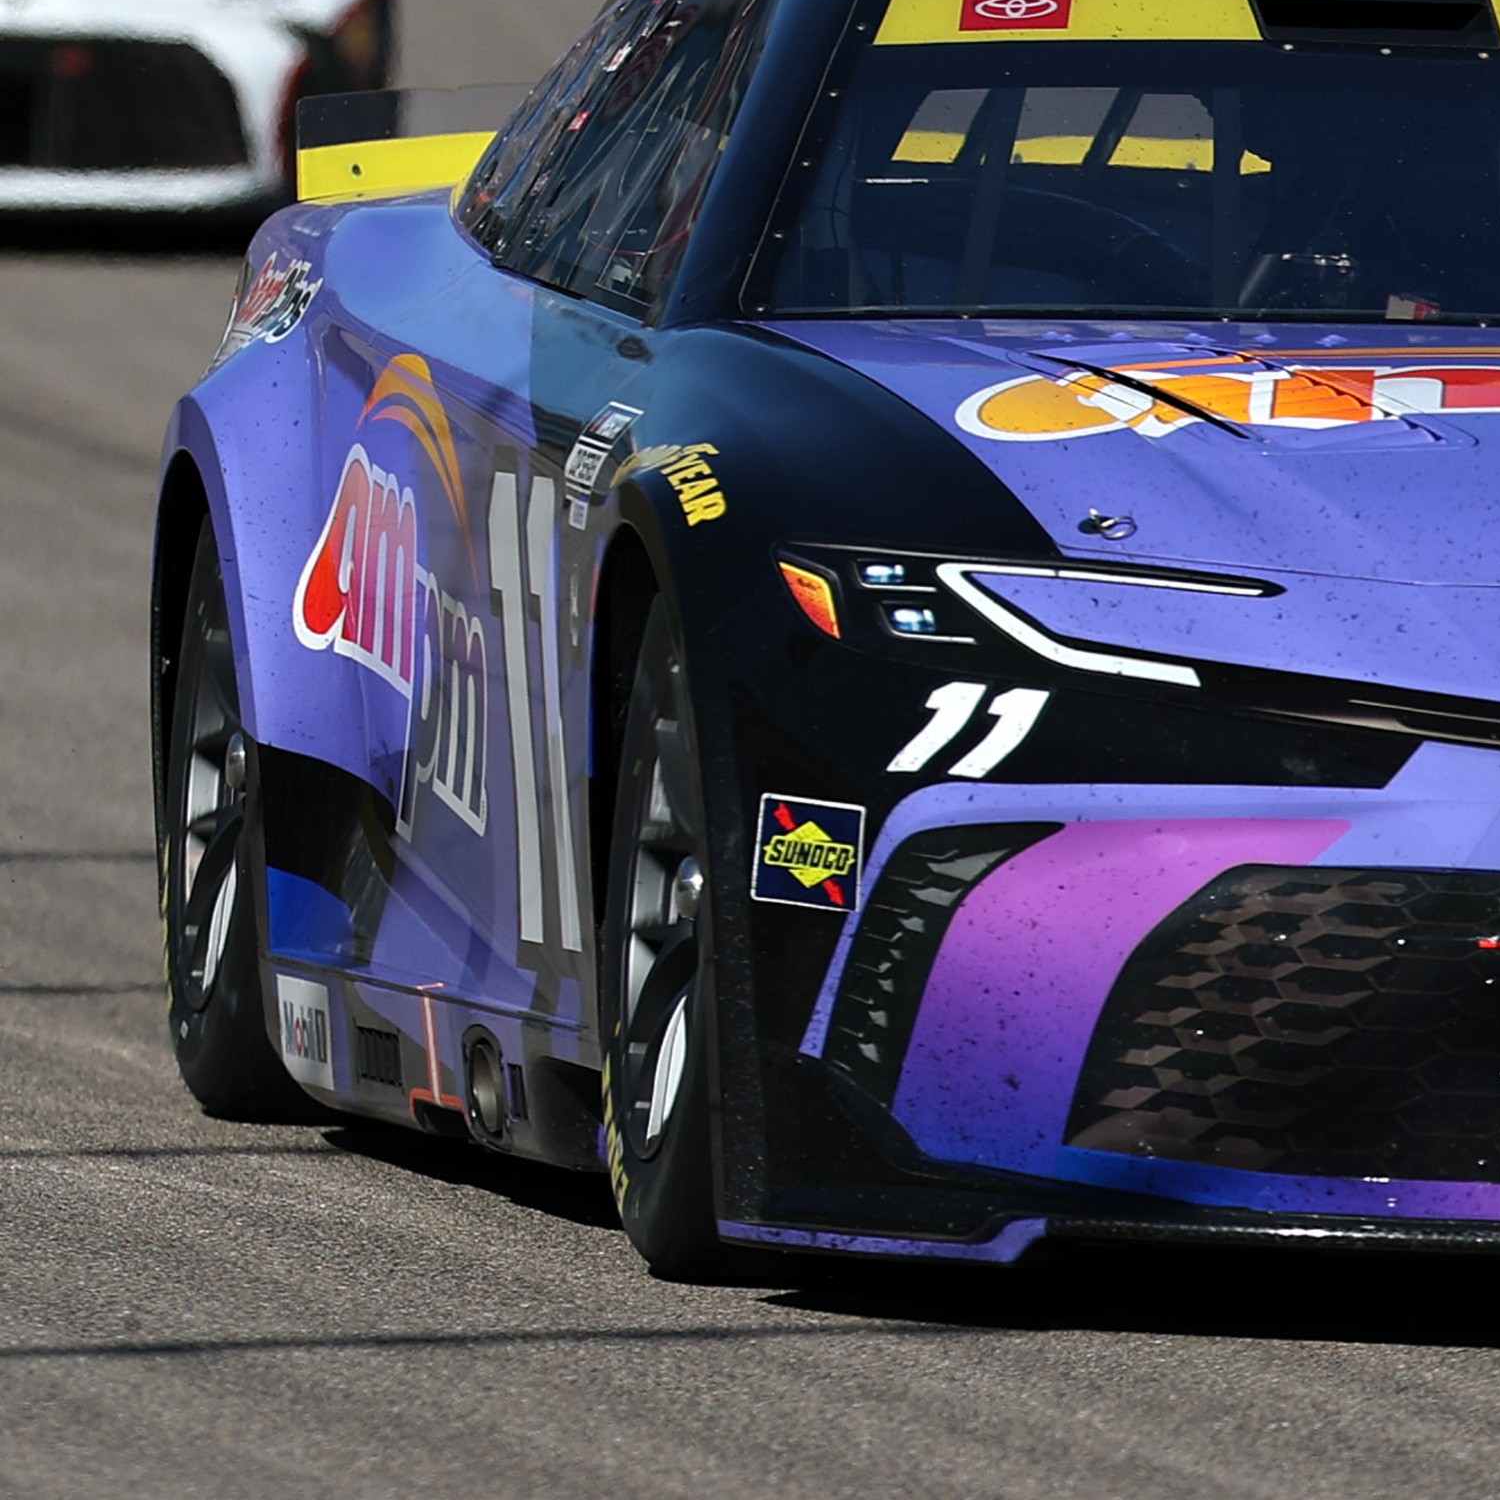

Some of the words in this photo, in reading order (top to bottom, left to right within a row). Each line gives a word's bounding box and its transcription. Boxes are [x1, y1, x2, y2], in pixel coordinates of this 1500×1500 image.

[488, 471, 582, 953] 11
[886, 681, 1050, 779] 11
[767, 837, 850, 872] SUNOCO
